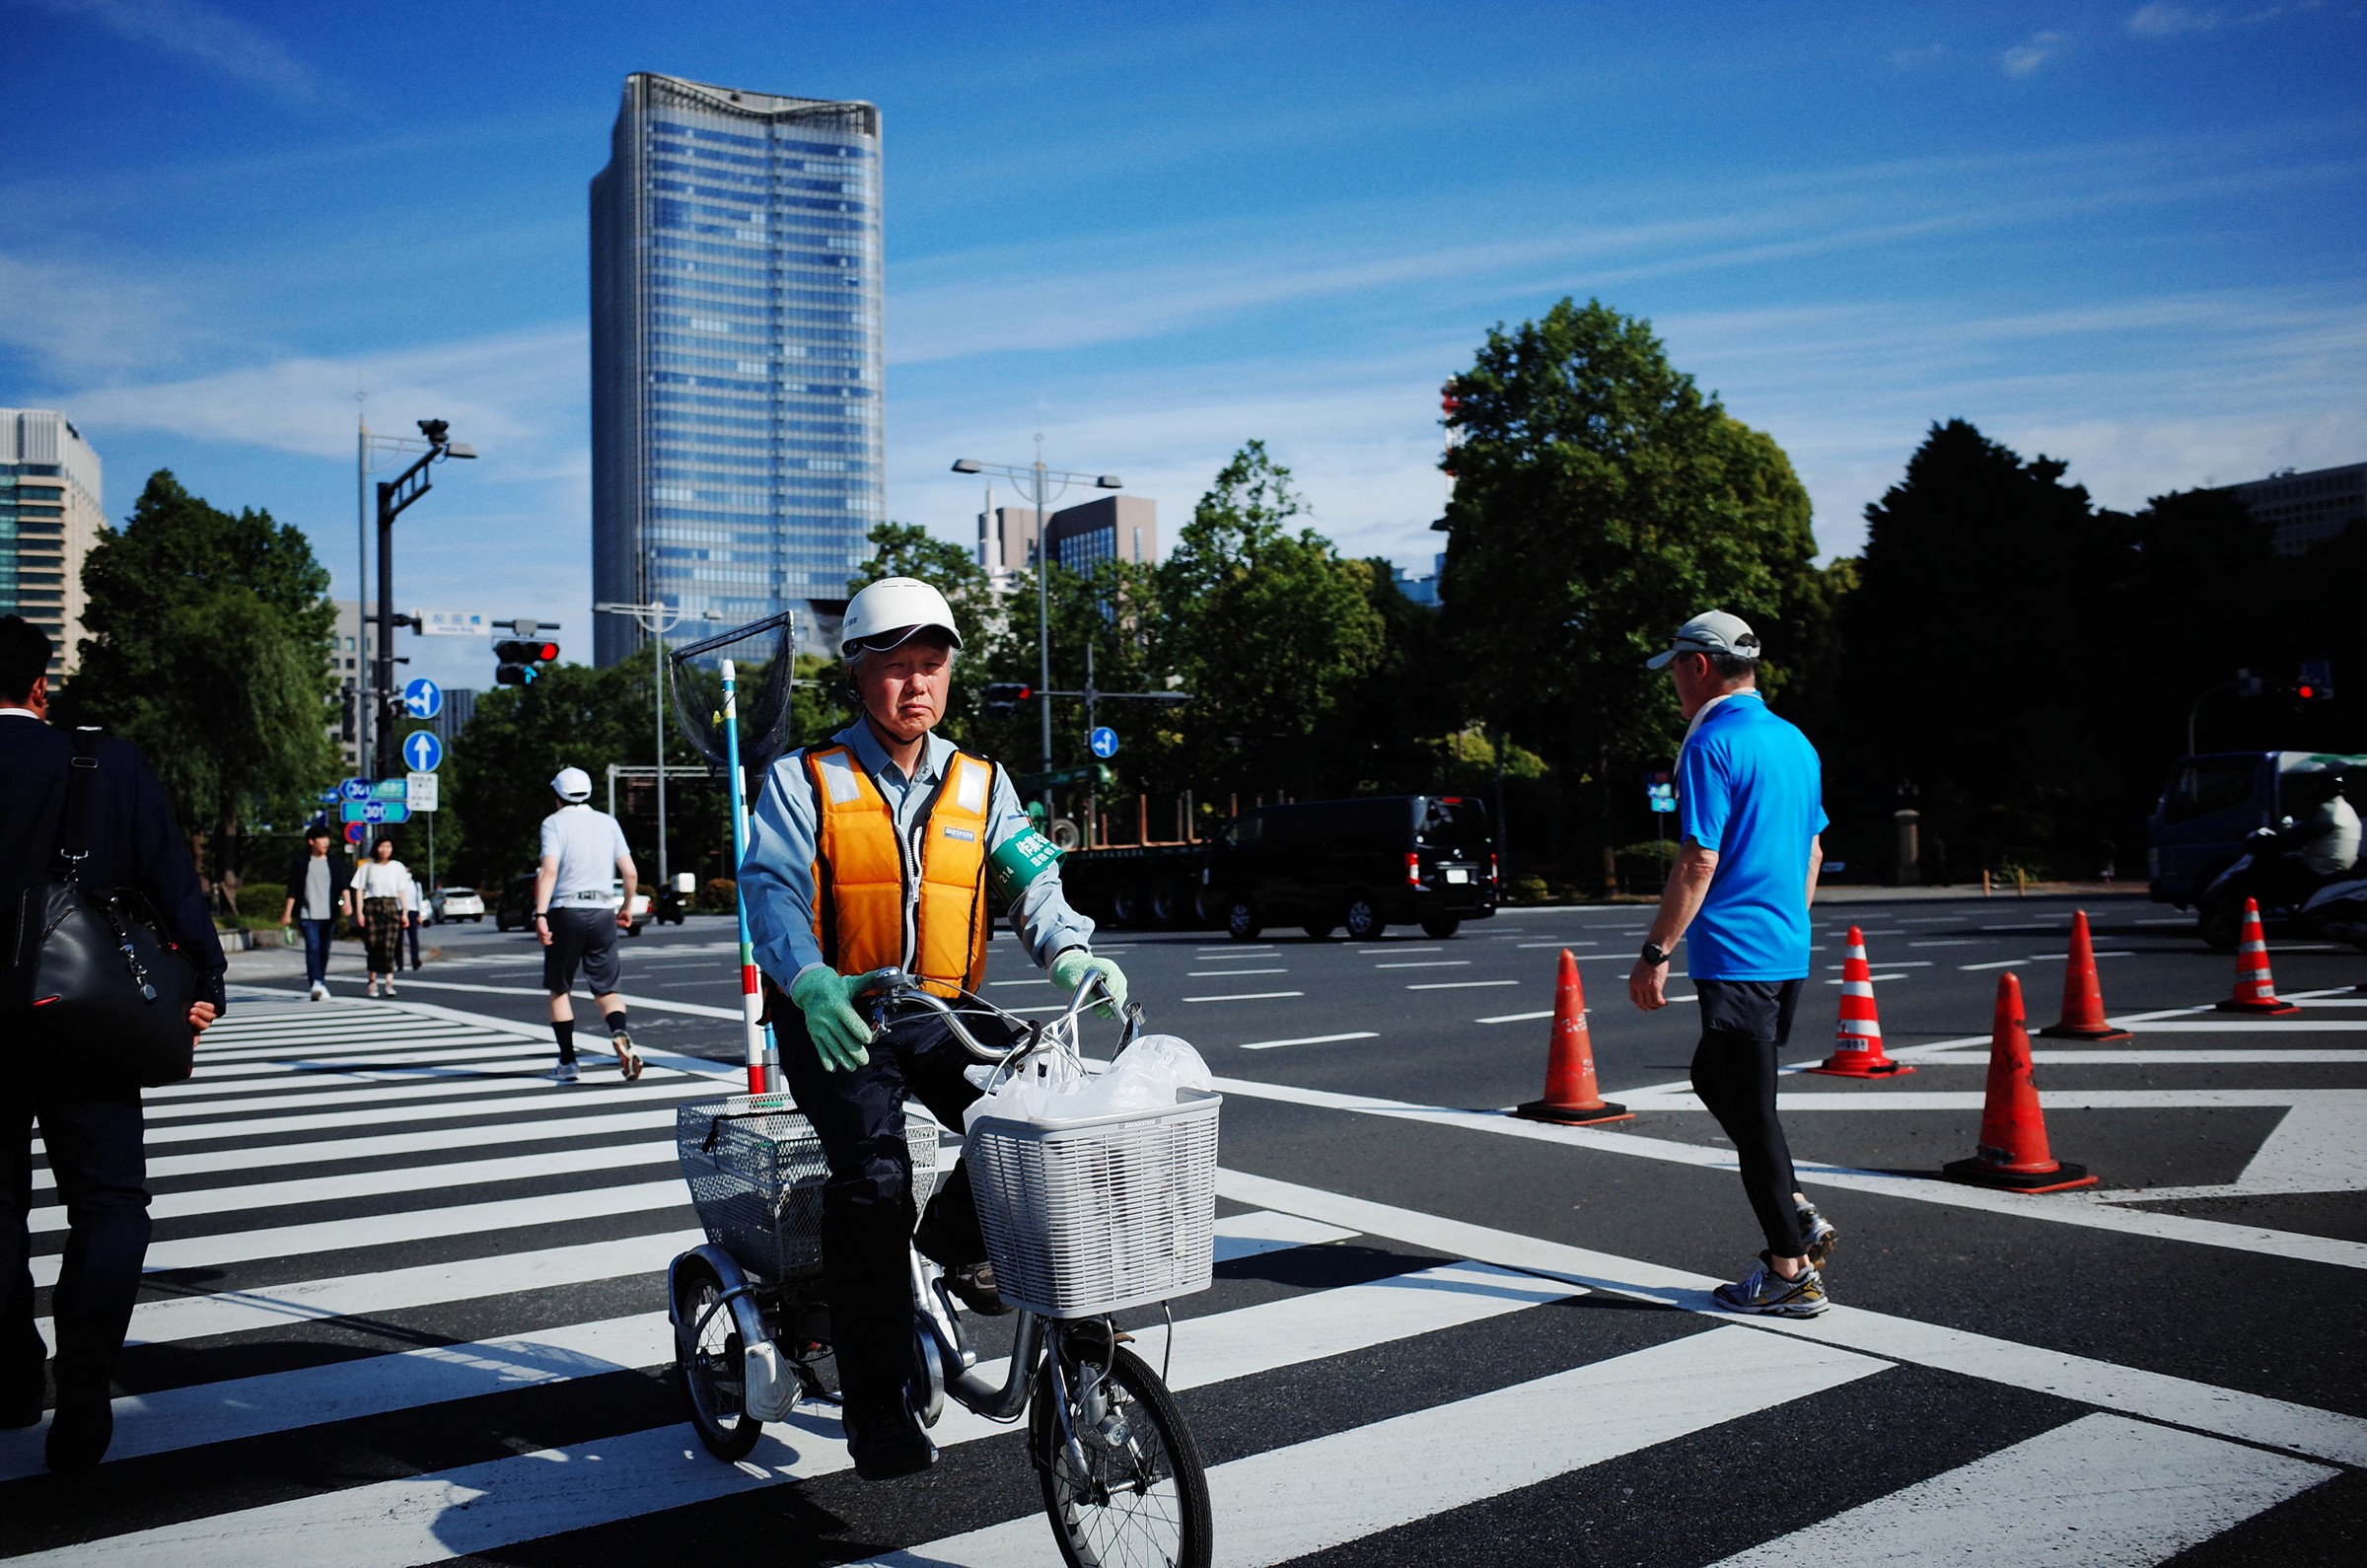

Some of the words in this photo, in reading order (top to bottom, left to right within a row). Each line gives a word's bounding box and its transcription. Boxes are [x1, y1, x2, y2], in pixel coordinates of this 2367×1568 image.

[350, 784, 371, 796] 301
[365, 806, 386, 819] 301
[999, 866, 1015, 885] 214
